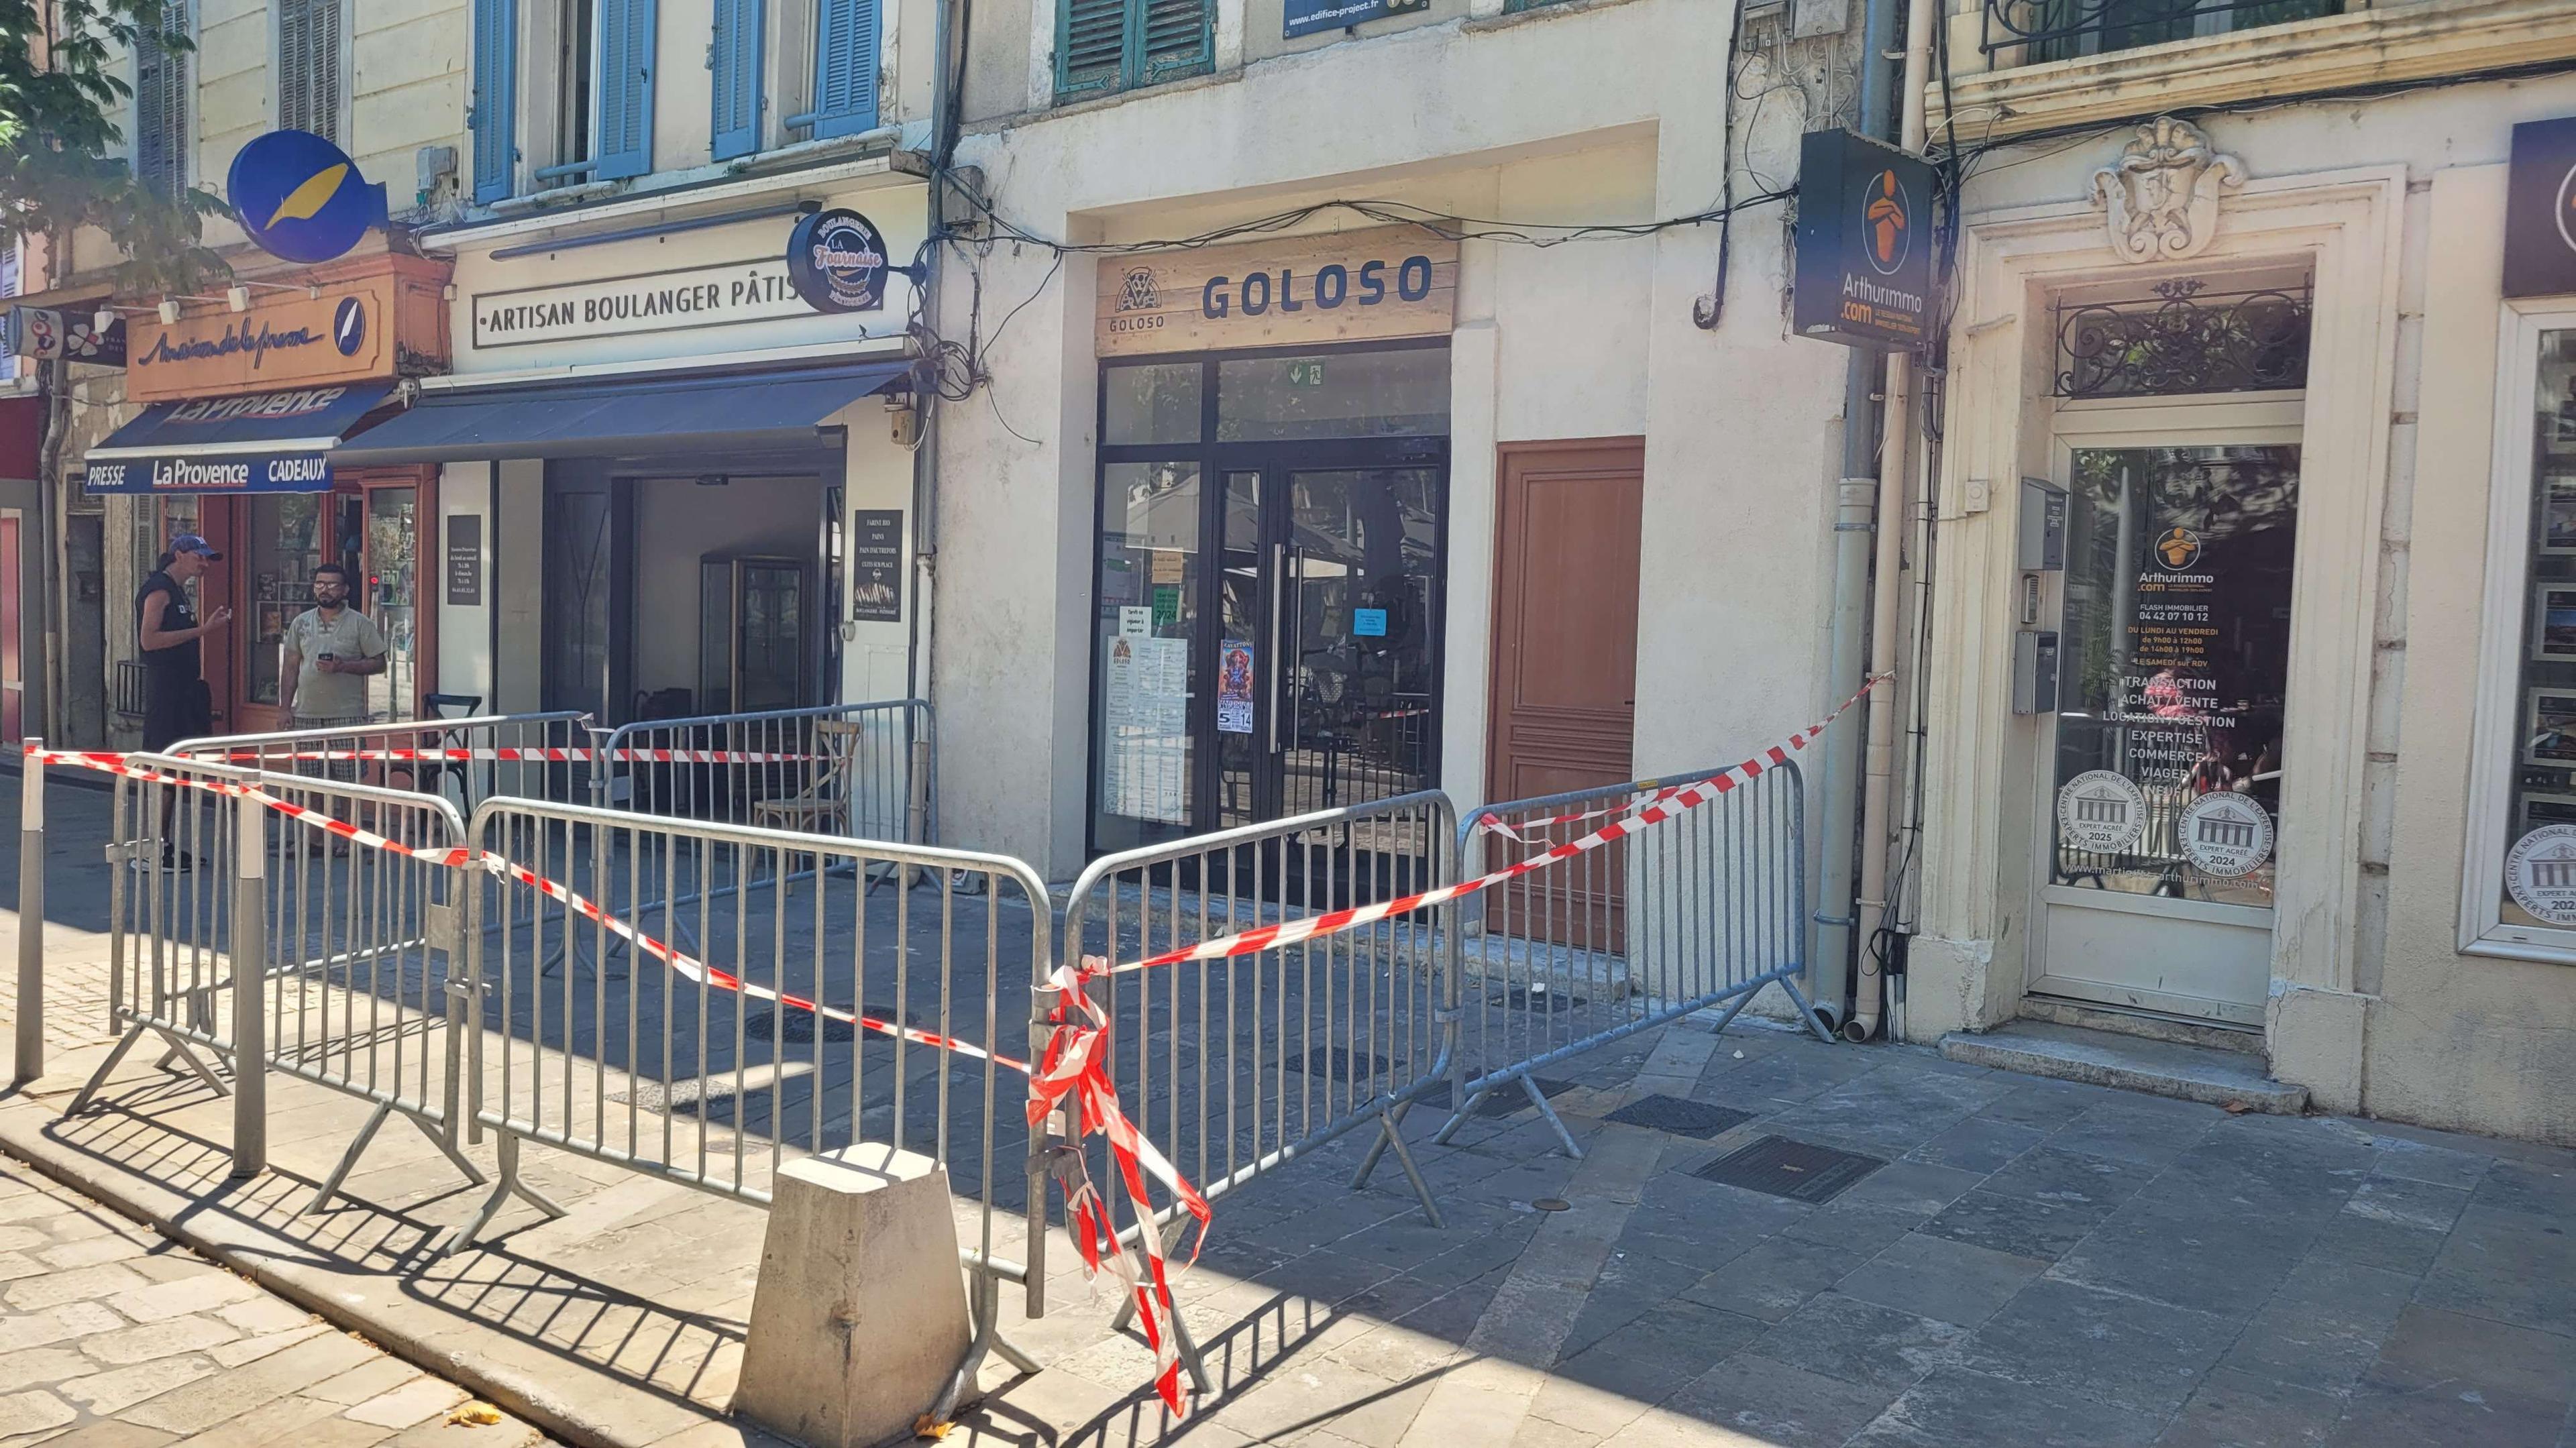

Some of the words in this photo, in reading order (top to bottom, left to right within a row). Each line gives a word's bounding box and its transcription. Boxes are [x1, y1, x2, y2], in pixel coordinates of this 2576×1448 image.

[1289, 0, 1379, 26] www.edifice-project.fr
[818, 216, 872, 241] BOULANGERIE
[831, 239, 844, 249] LA
[813, 244, 883, 270] Fournaise
[1202, 255, 1433, 319] GOLOSO
[1842, 272, 1922, 313] Arthurimmo
[490, 301, 574, 333] ARTISAN
[585, 283, 720, 323] BOULANGER
[1841, 301, 1872, 324] .com
[1110, 316, 1164, 332] GOLOSO
[88, 465, 125, 486] PRESSE
[175, 459, 249, 484] Provence
[268, 458, 326, 482] CADEAUX
[2139, 572, 2214, 583] Arthurimmo
[2137, 583, 2165, 592] .com
[1157, 610, 1177, 620] 2024
[2139, 612, 2151, 620] 04
[2153, 612, 2165, 620] 42
[2167, 612, 2180, 620] 07
[2182, 613, 2194, 621] 10
[2196, 613, 2208, 621] 12
[2125, 676, 2216, 690] TRANSACTION
[2122, 693, 2162, 706] ACHAT
[2175, 696, 2218, 708] VENTE
[1218, 713, 1230, 724] 5
[1241, 714, 1251, 727] 14
[2102, 710, 2165, 724] LOCATION
[2178, 715, 2236, 728] GESTION
[2131, 730, 2204, 744] EXPERTISE
[2129, 748, 2203, 763] COMMERCE
[2141, 766, 2188, 779] VIAGER
[2060, 787, 2073, 814] CENTRE
[2072, 773, 2108, 788] NATIONAL
[2110, 775, 2120, 783] DE
[2122, 781, 2143, 820] L'EXPERTISE
[2147, 785, 2182, 797] NEUF
[2179, 806, 2195, 834] CENTRE
[2194, 792, 2235, 807] NATIONAL
[2237, 795, 2248, 804] DE
[2250, 801, 2272, 845] L'EXPERTISE
[2061, 818, 2088, 846] EXPERTS
[2092, 822, 2142, 850] IMMOBILIERS
[2088, 832, 2112, 842] 2025
[2199, 844, 2224, 852] EXPERT
[2509, 850, 2523, 881] CENTRE
[2520, 828, 2569, 850] NATIONAL
[2180, 838, 2209, 870] EXPERTS
[2212, 848, 2269, 876] IMMOBILIERS
[2209, 855, 2235, 867] 2024
[2512, 885, 2551, 919] EXPERTS
[2551, 900, 2576, 910] 202
